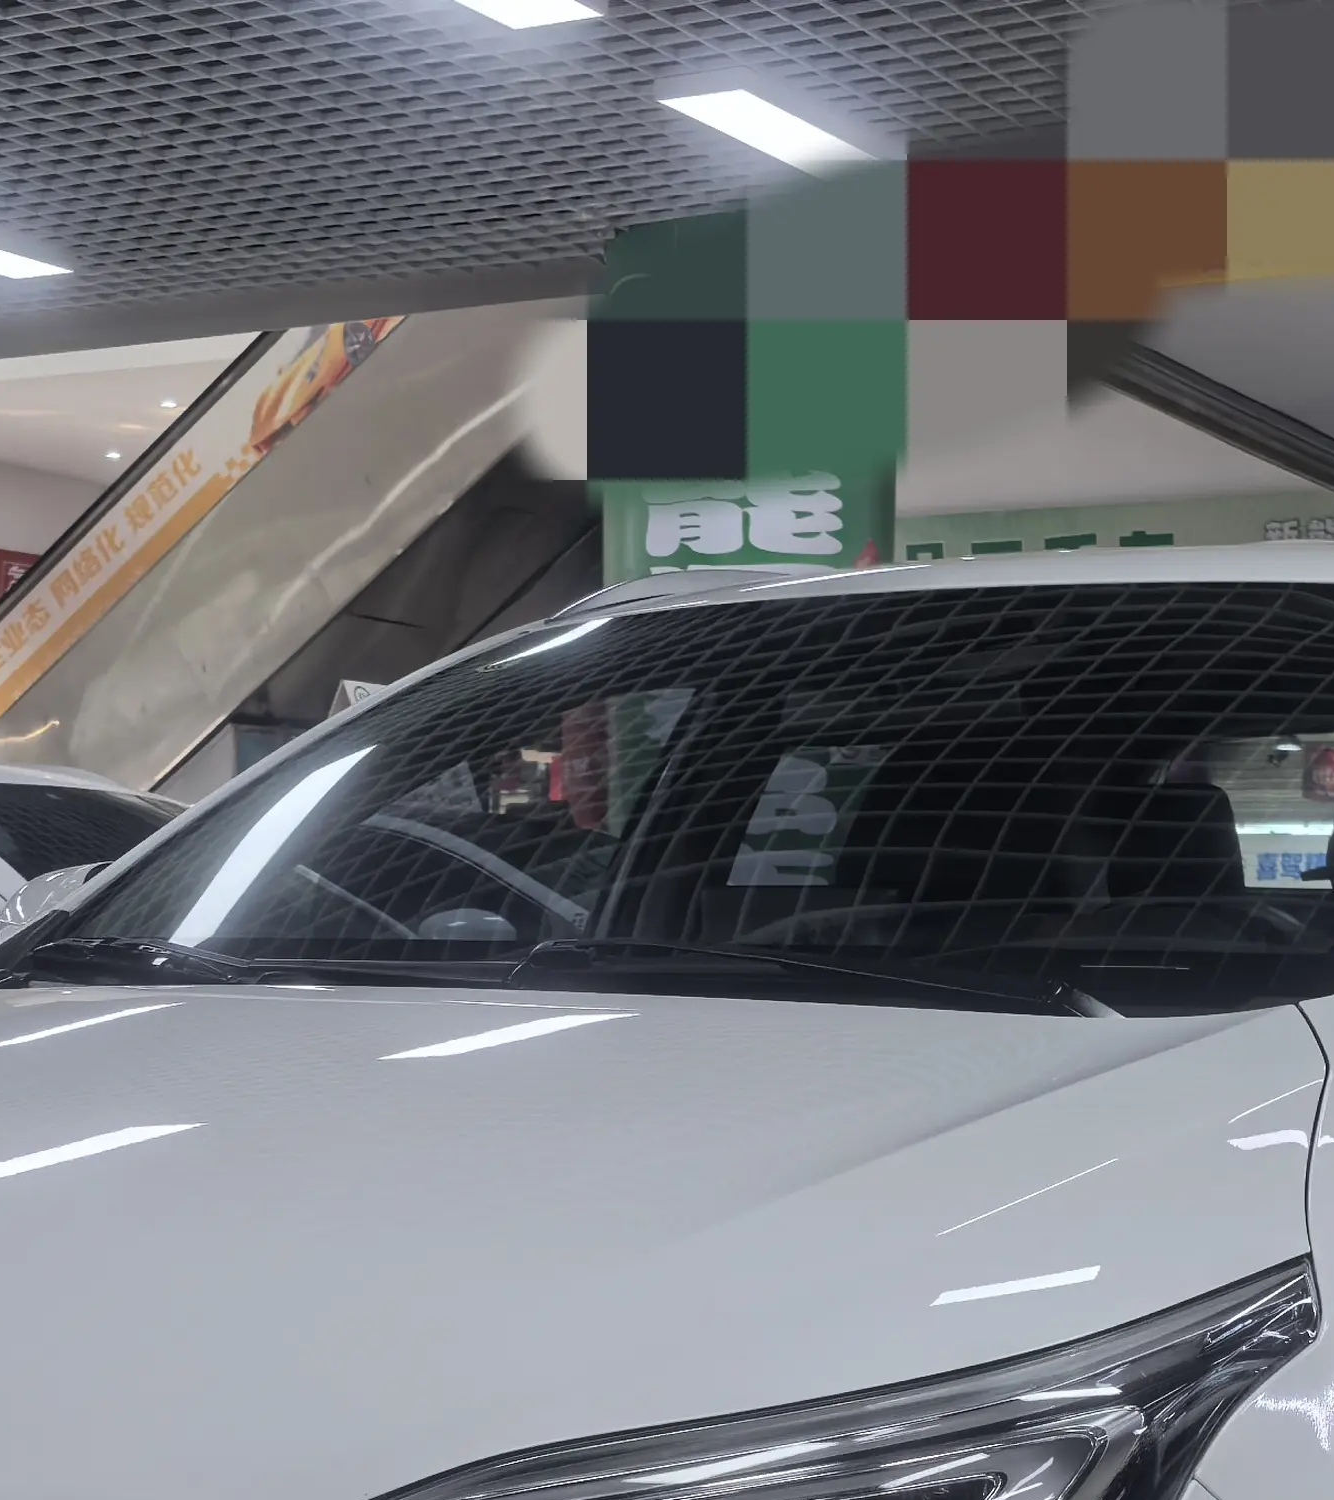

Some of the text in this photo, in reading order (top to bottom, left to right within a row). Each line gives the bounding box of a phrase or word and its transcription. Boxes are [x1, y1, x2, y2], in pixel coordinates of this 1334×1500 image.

[123, 448, 203, 535] 规范化
[48, 525, 125, 608] 网络化
